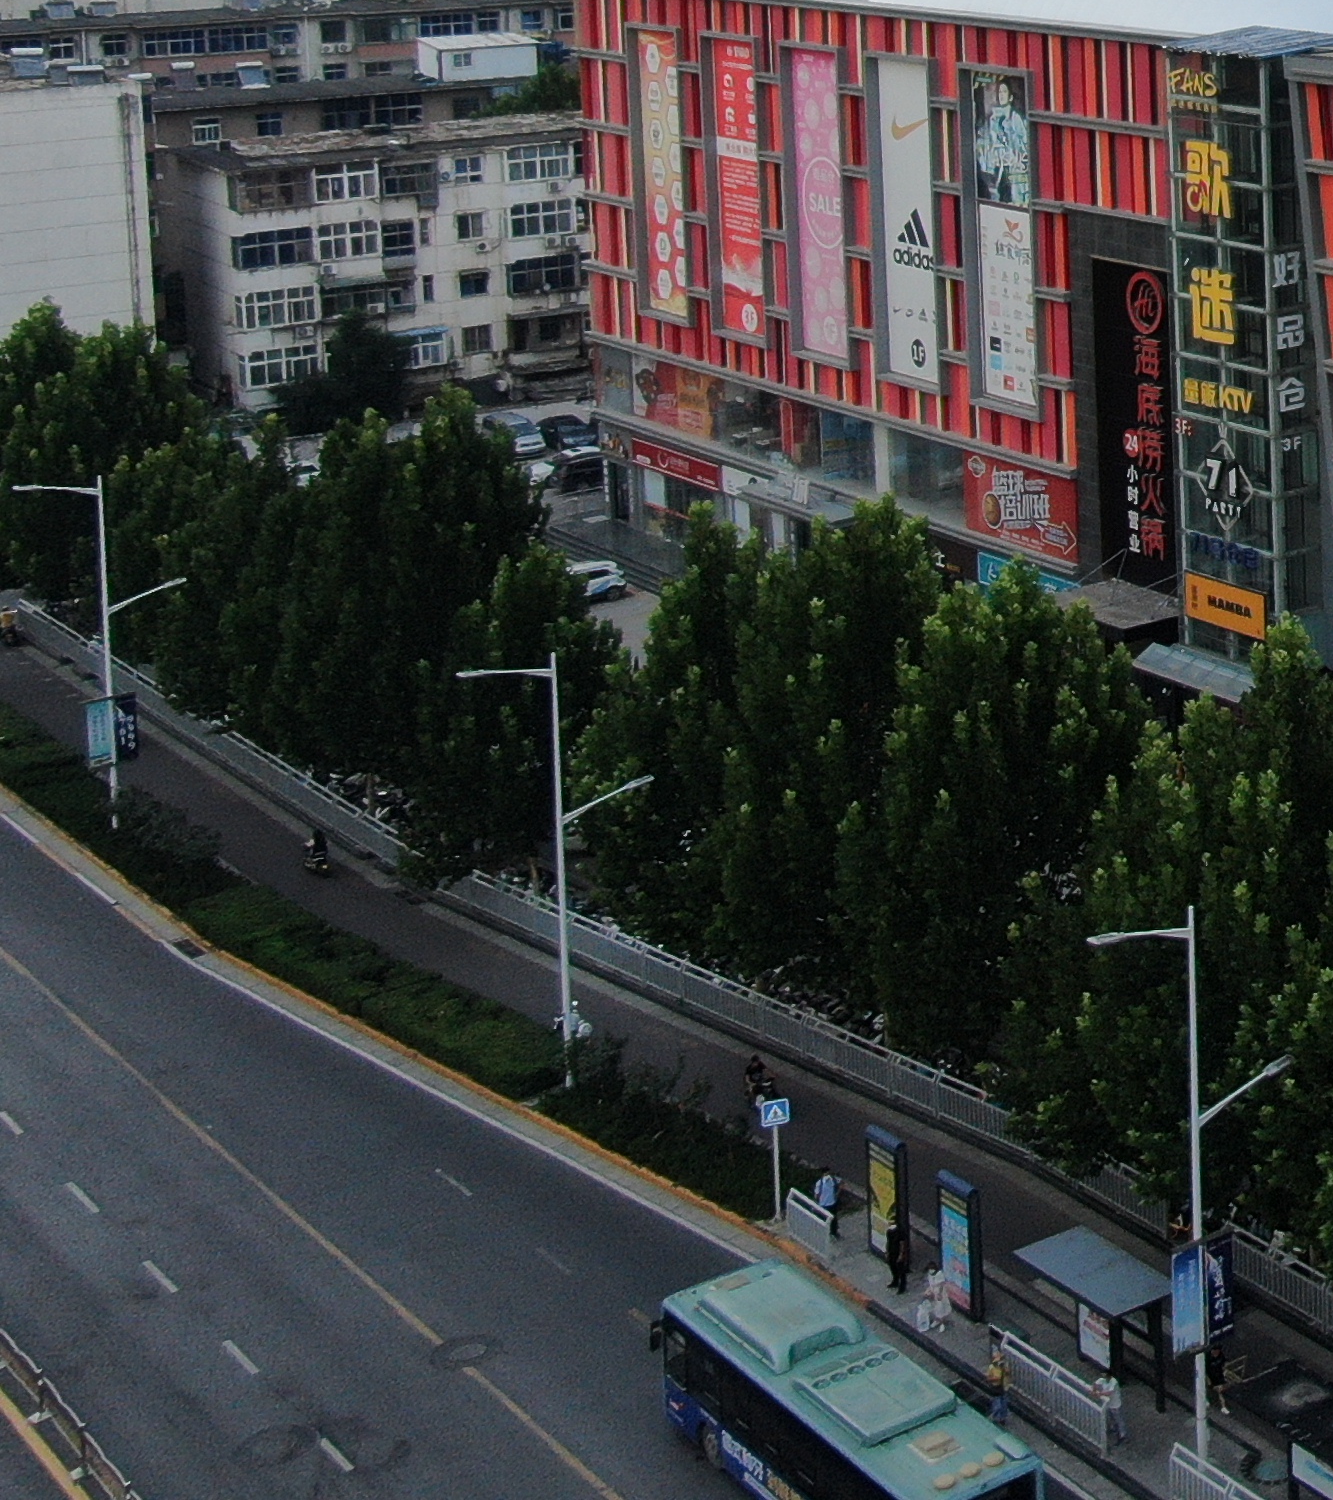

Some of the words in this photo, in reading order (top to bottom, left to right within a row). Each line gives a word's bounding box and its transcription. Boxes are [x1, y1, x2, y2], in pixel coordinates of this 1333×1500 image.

[1168, 67, 1217, 97] FANS
[808, 192, 841, 218] SALE
[1185, 139, 1236, 346] 歌迷
[1273, 251, 1306, 414] 好品仓
[911, 345, 925, 363] 1F
[1125, 433, 1139, 452] 24
[1134, 334, 1166, 562] 海底捞火锅
[1282, 436, 1302, 452] 3F
[992, 466, 1024, 496] 篮球
[1206, 458, 1237, 497] 71
[1000, 493, 1051, 521] 培训班
[1126, 463, 1140, 554] 小时营业
[1205, 498, 1241, 518] PARTY
[1207, 594, 1252, 619] MAMBA
